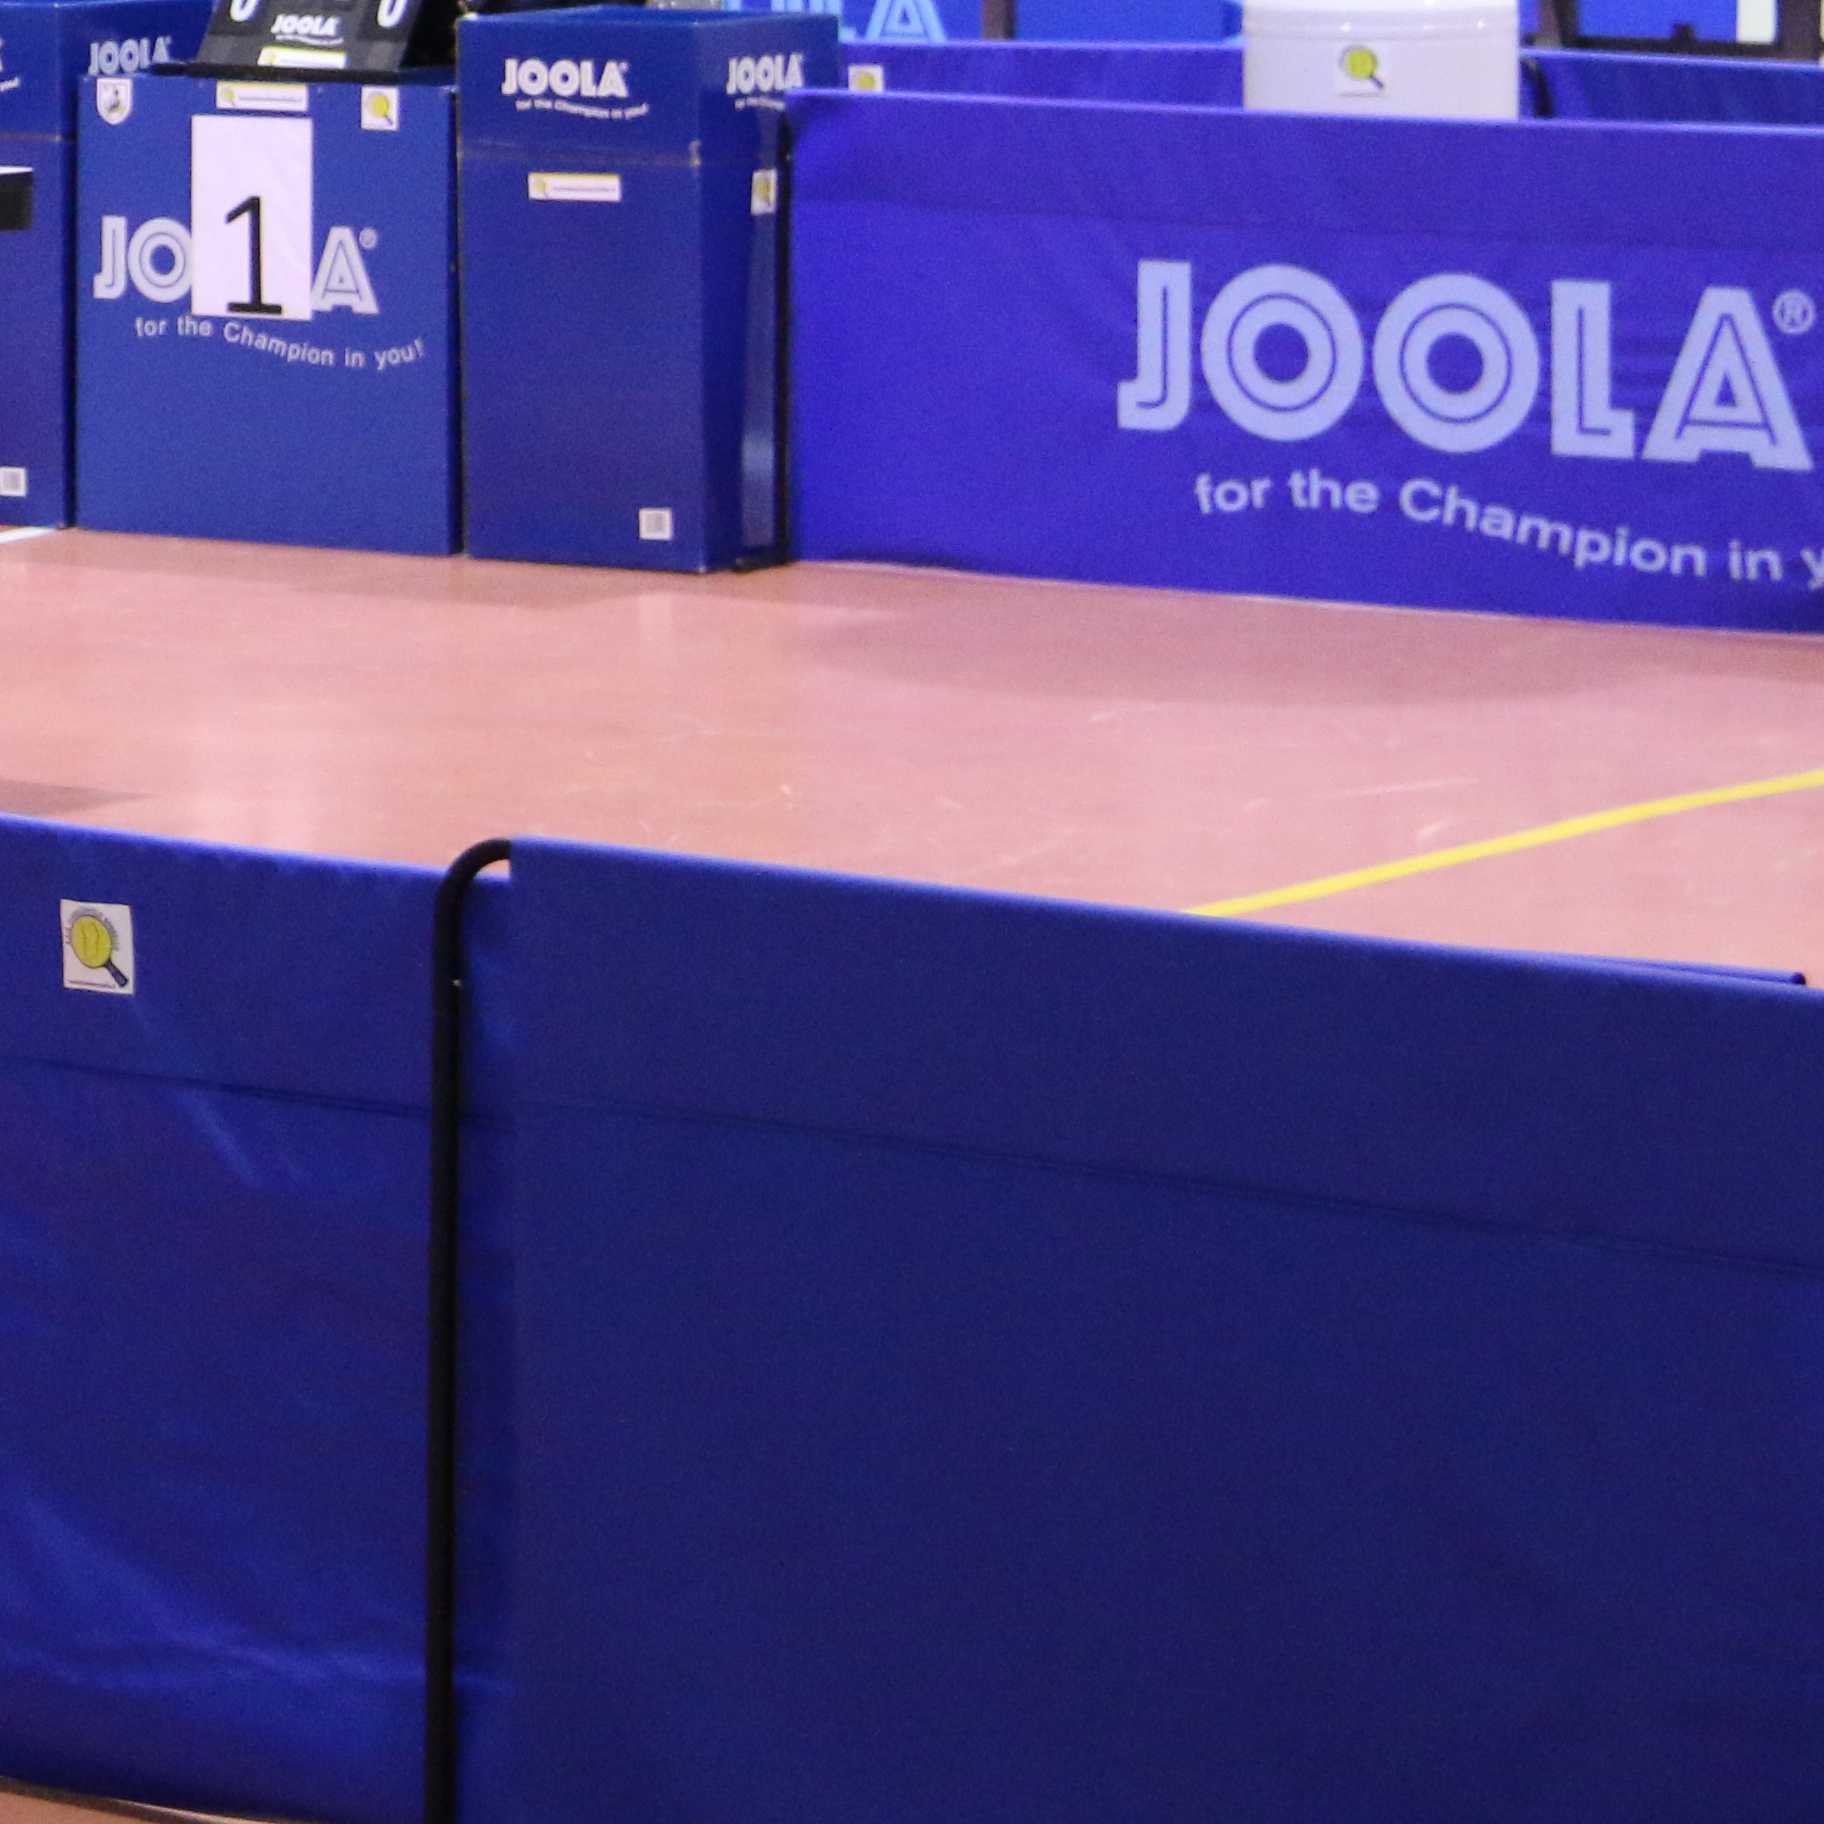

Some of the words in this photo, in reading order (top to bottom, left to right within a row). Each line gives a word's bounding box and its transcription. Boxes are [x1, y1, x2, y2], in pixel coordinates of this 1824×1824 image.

[225, 196, 284, 315] 1
[135, 316, 167, 338] for
[177, 314, 213, 338] the
[223, 322, 335, 368] Champion
[344, 347, 365, 368] in
[1194, 472, 1273, 516] for
[1289, 469, 1379, 514] the
[1400, 479, 1707, 579] Champion
[1728, 540, 1782, 582] in
